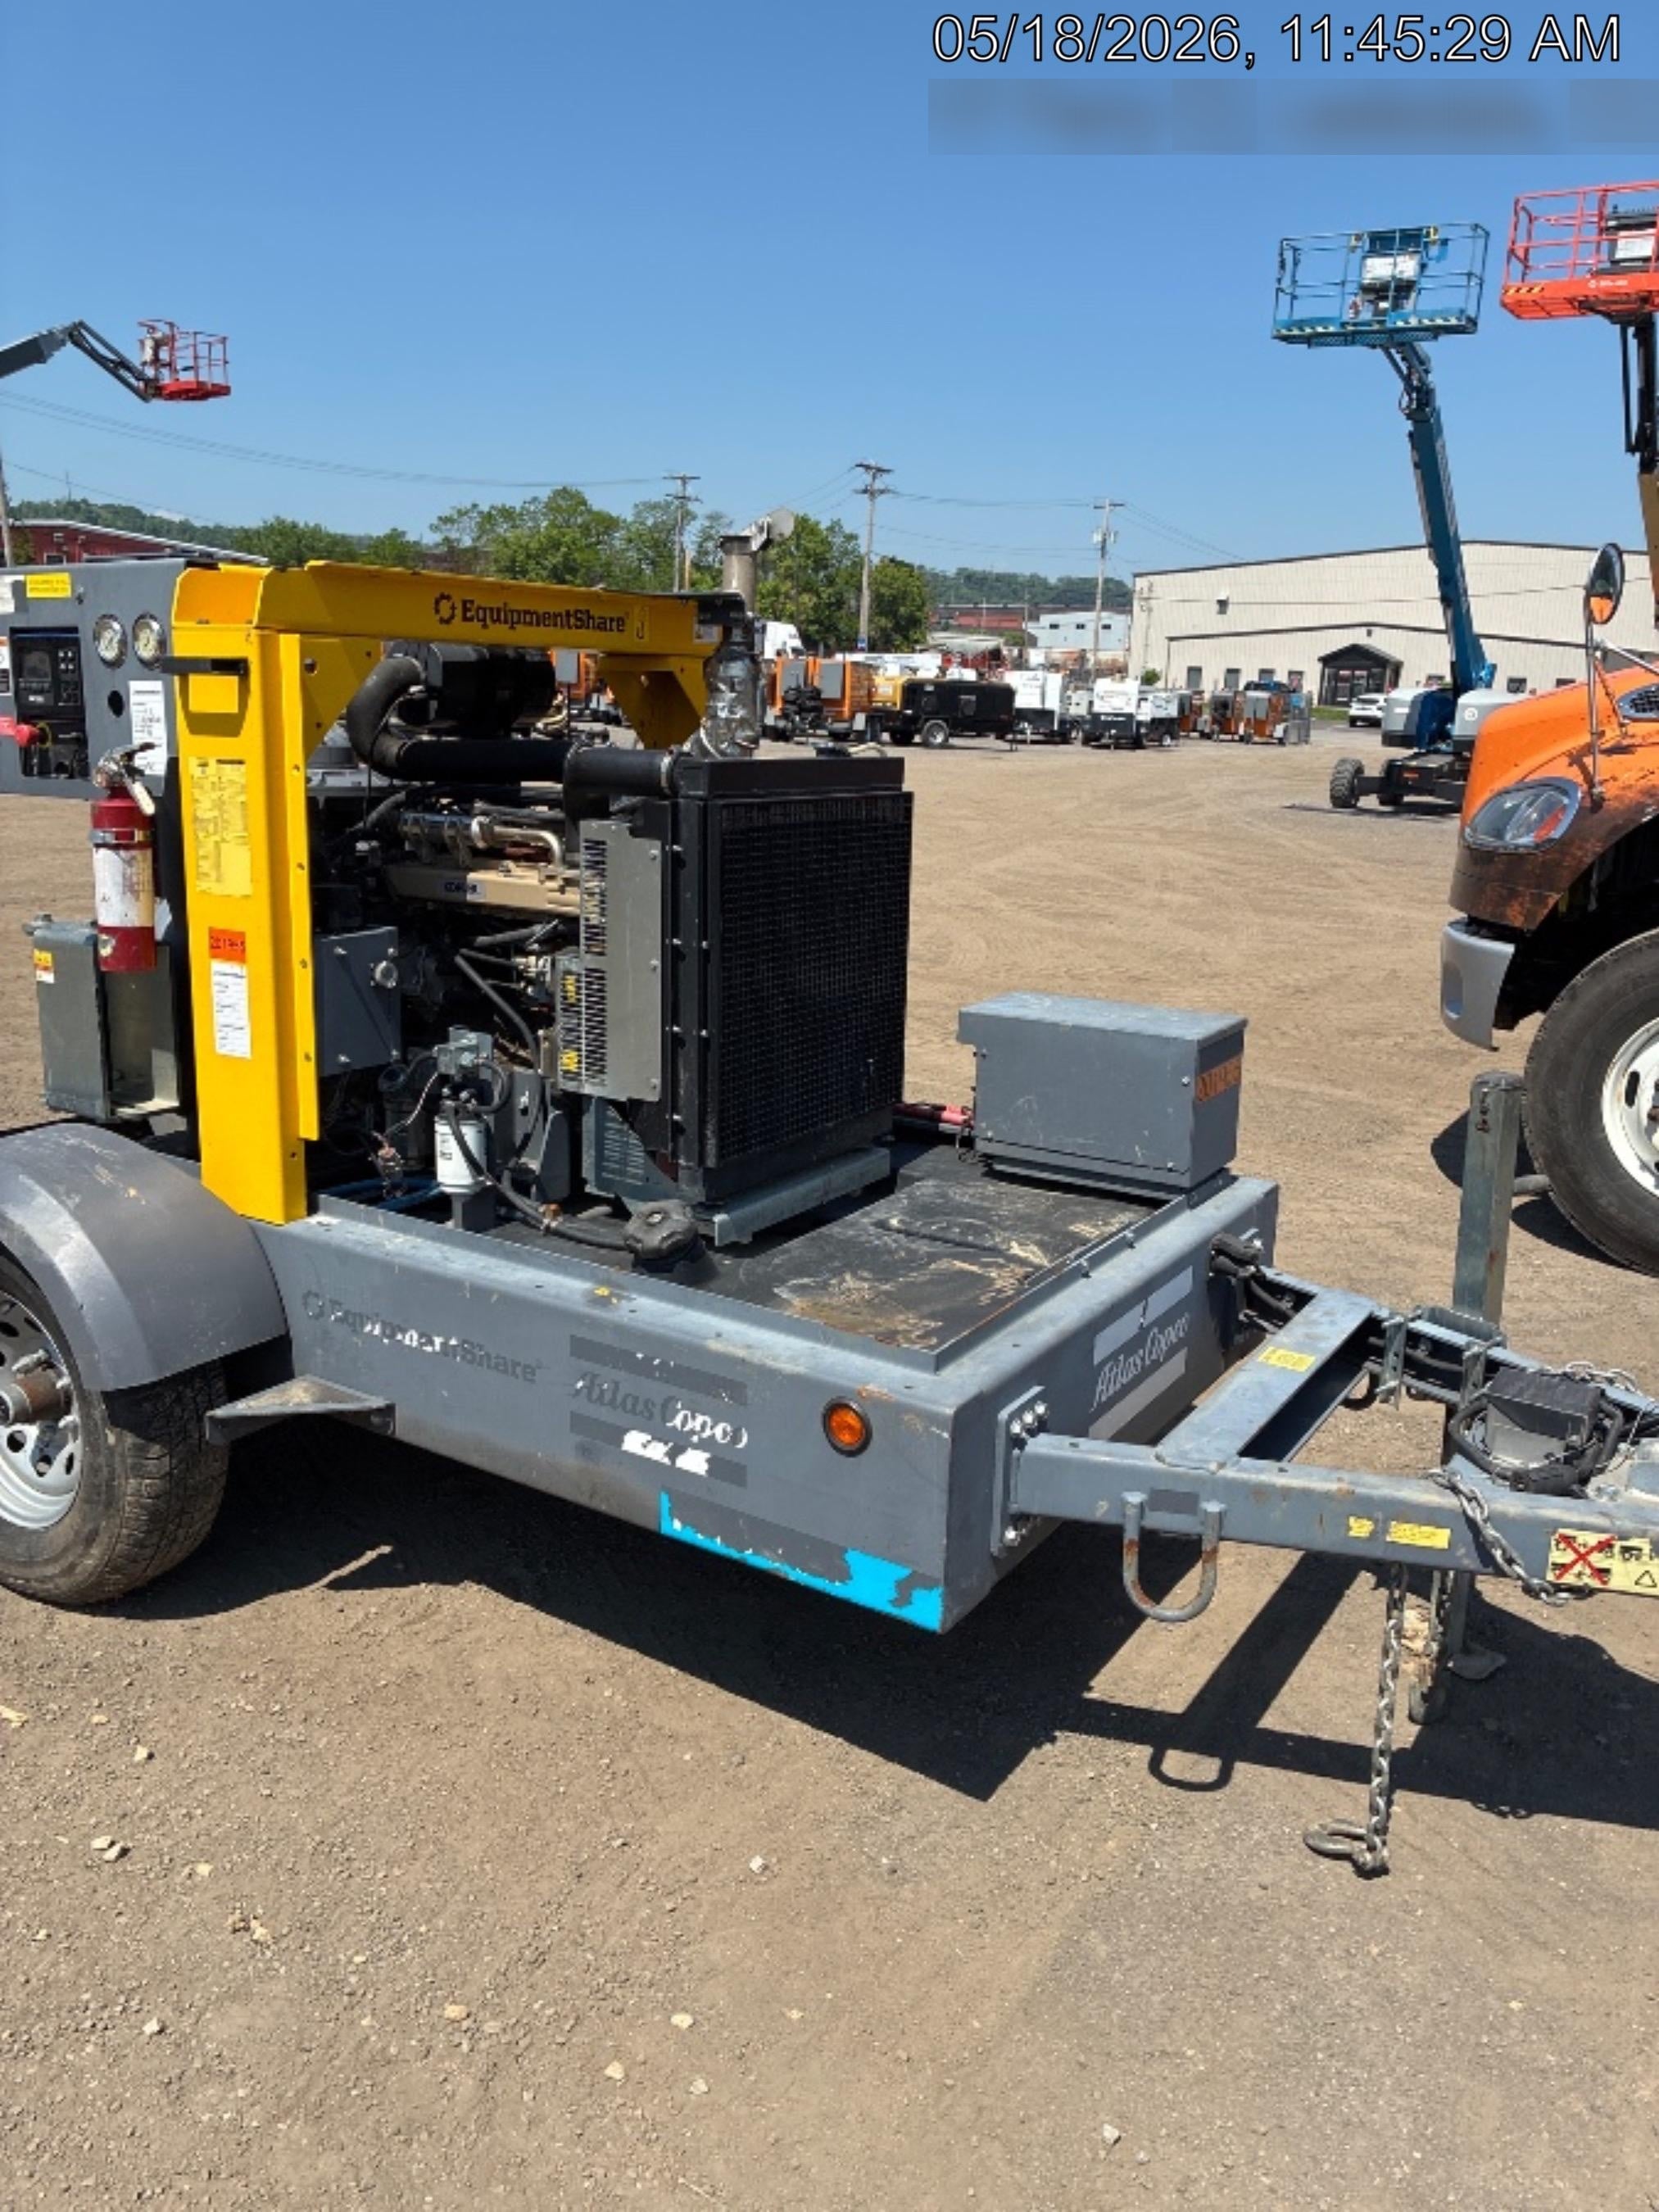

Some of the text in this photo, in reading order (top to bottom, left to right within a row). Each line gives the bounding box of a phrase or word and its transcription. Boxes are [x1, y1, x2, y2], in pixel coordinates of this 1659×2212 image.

[461, 598, 626, 632] EquipmentShare
[571, 1371, 655, 1421] Atlas
[1089, 1349, 1144, 1413] Atlas
